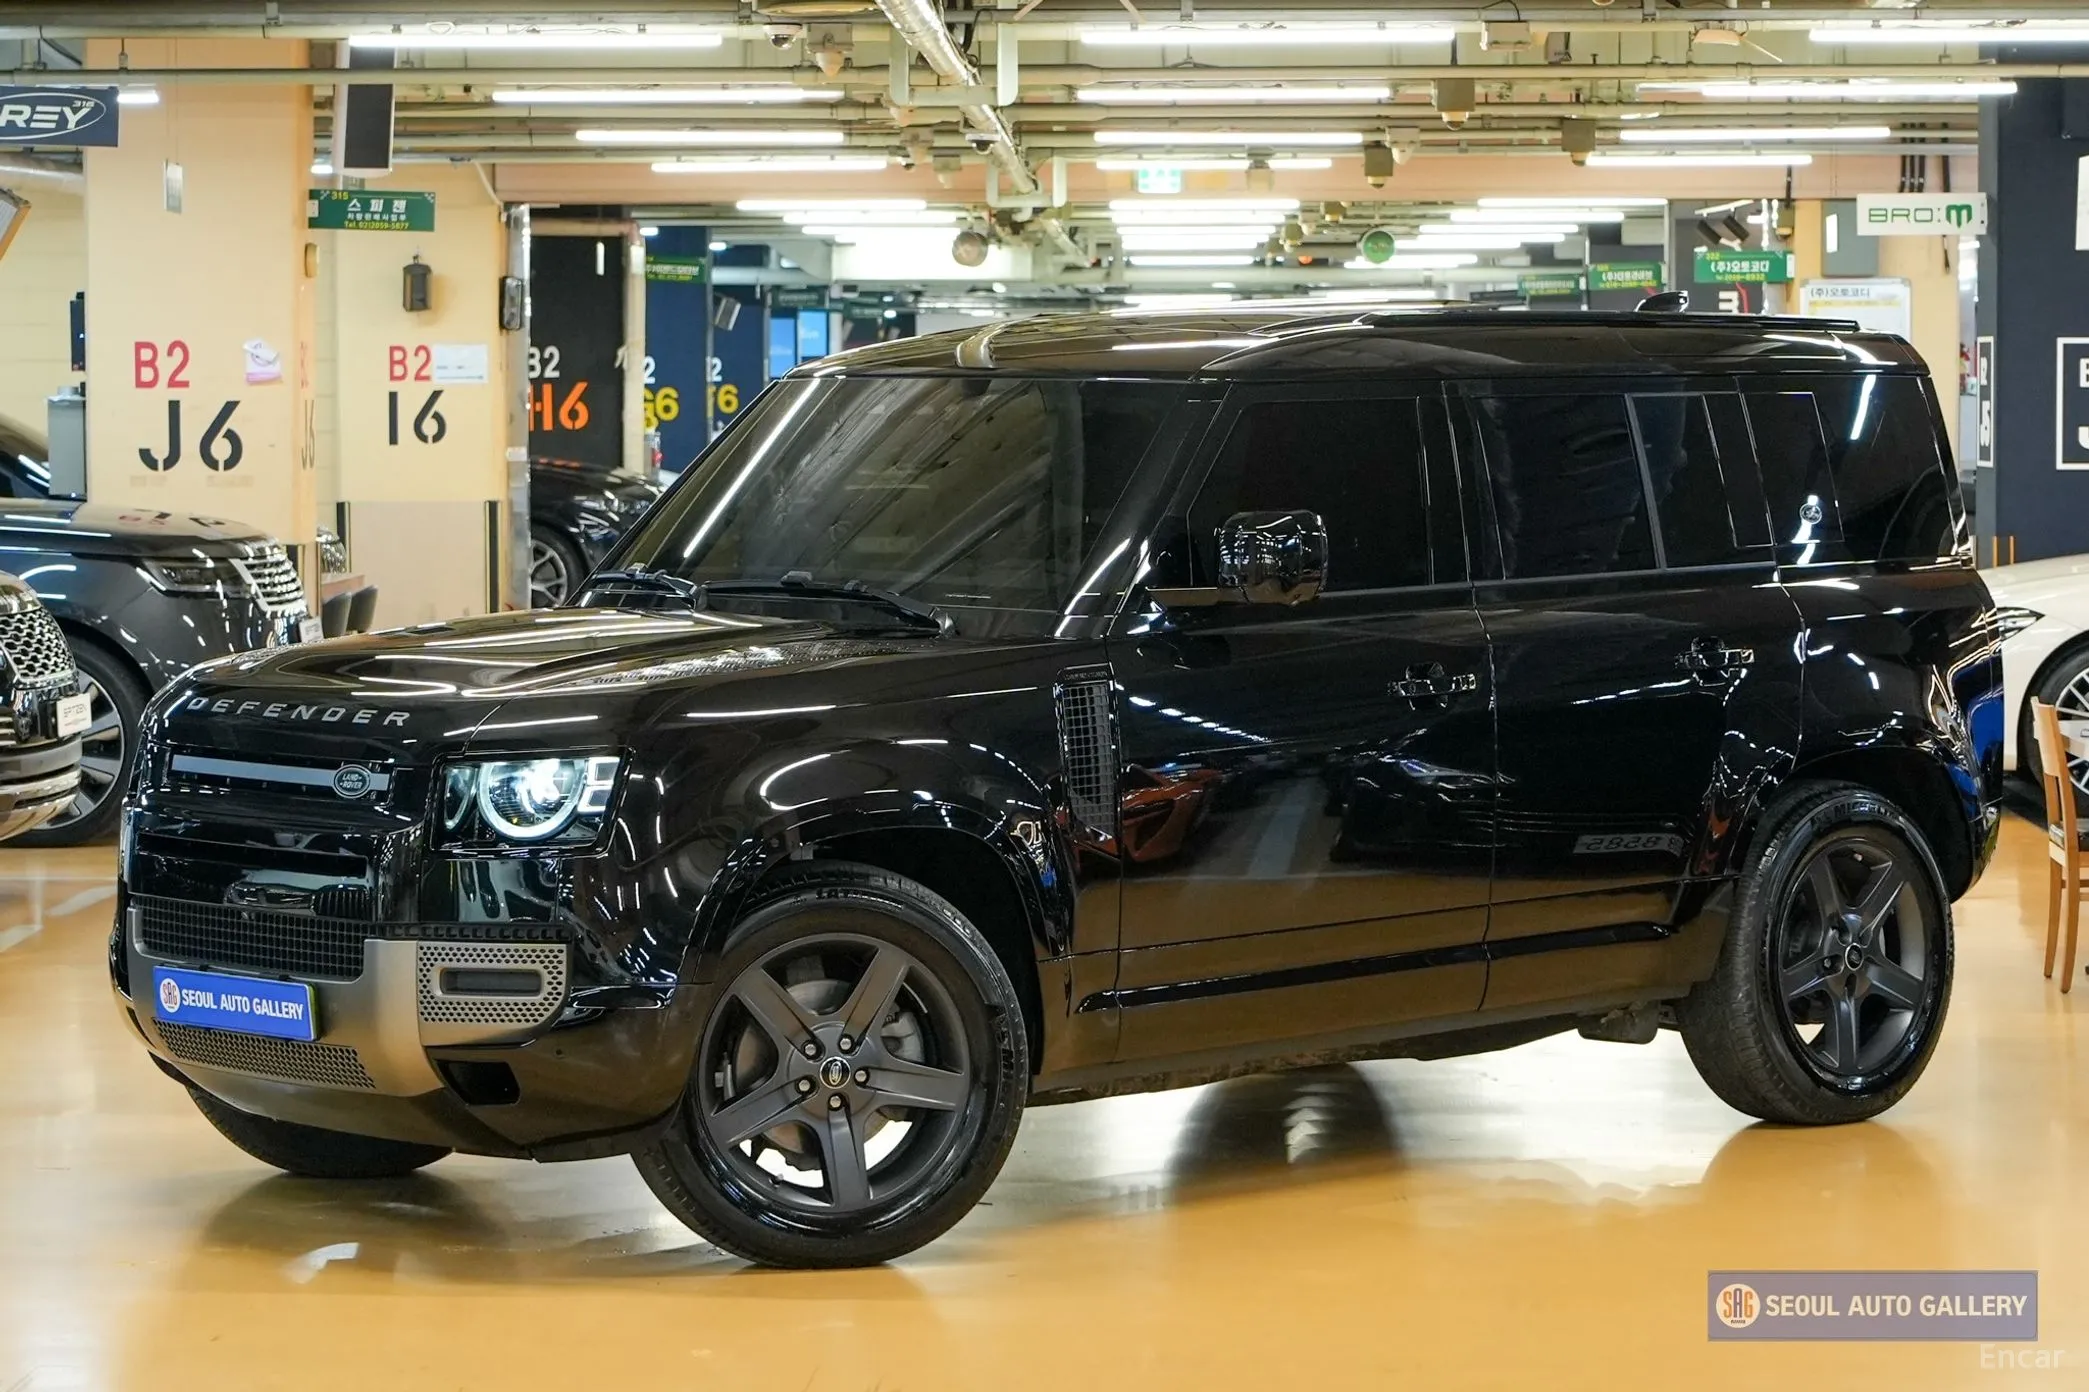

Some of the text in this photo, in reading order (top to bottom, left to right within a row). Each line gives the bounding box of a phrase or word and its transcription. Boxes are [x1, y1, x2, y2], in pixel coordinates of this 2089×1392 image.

[134, 340, 190, 388] B2
[389, 345, 431, 381] B2
[644, 356, 656, 384] 2
[139, 400, 243, 471] J6
[187, 697, 410, 727] DEFENDER
[181, 989, 304, 1020] SEOUL AUTO GALLERY
